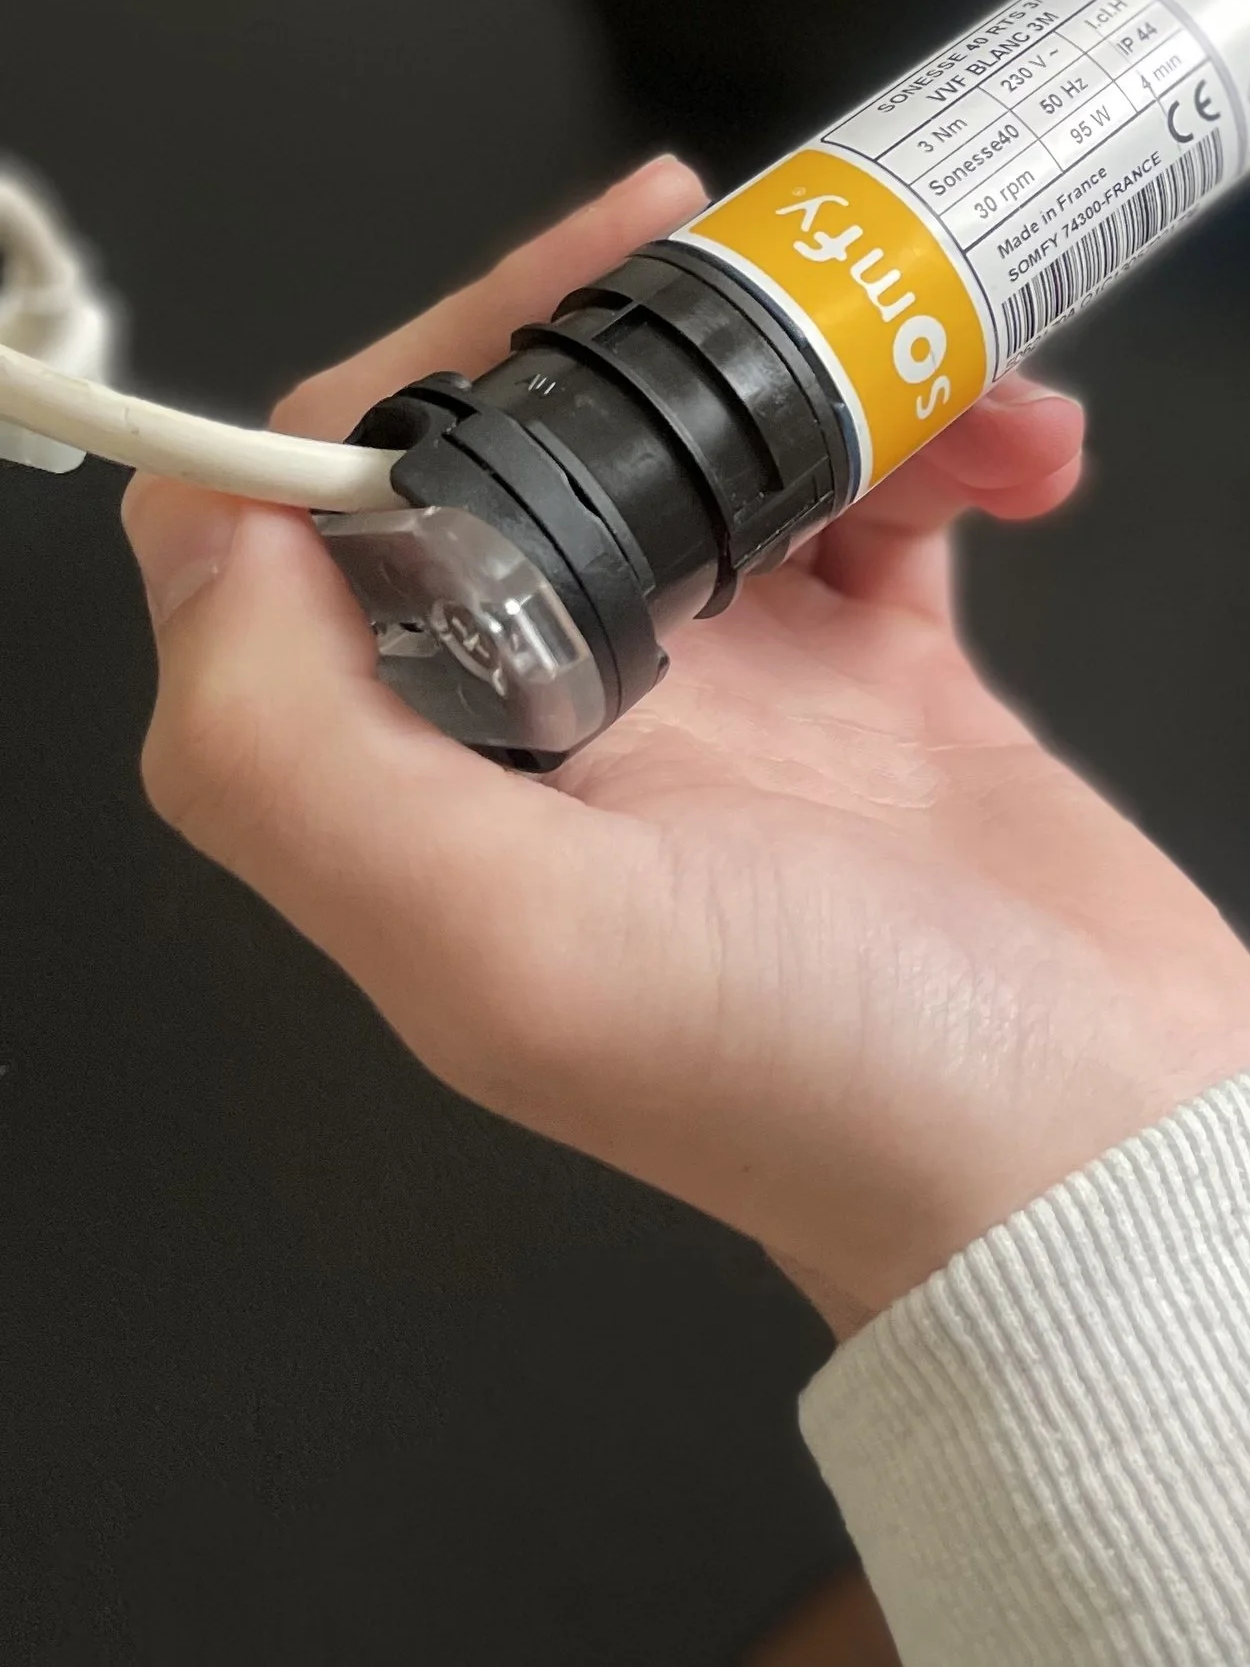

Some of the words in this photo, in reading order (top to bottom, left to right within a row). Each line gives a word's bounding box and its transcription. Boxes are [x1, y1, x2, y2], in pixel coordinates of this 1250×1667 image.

[877, 51, 967, 113] SONESSE
[966, 37, 989, 51] 40
[987, 11, 1026, 38] RTS
[926, 74, 968, 103] VVF
[965, 31, 1030, 76] BLANC
[1028, 11, 1059, 33] 3M
[1115, 35, 1136, 56] IP
[1136, 21, 1158, 42] 44
[1000, 67, 1033, 93] 230
[1029, 54, 1047, 69] V
[1039, 93, 1063, 115] 50
[1060, 76, 1089, 99] Hz
[1139, 73, 1152, 90] 4
[1152, 53, 1183, 82] min
[917, 140, 934, 154] 3
[932, 118, 967, 143] Nm
[1069, 121, 1092, 145] 95
[1089, 105, 1112, 128] W
[929, 123, 1020, 197] Sonesse40
[973, 195, 998, 220] 30
[1000, 169, 1036, 203] rpm
[997, 218, 1040, 260] Made
[1041, 206, 1058, 223] in
[1055, 166, 1108, 212] France
[1007, 235, 1060, 283] SOMFY
[1061, 150, 1163, 239] 74300-FRANCE
[775, 194, 950, 421] somfy
